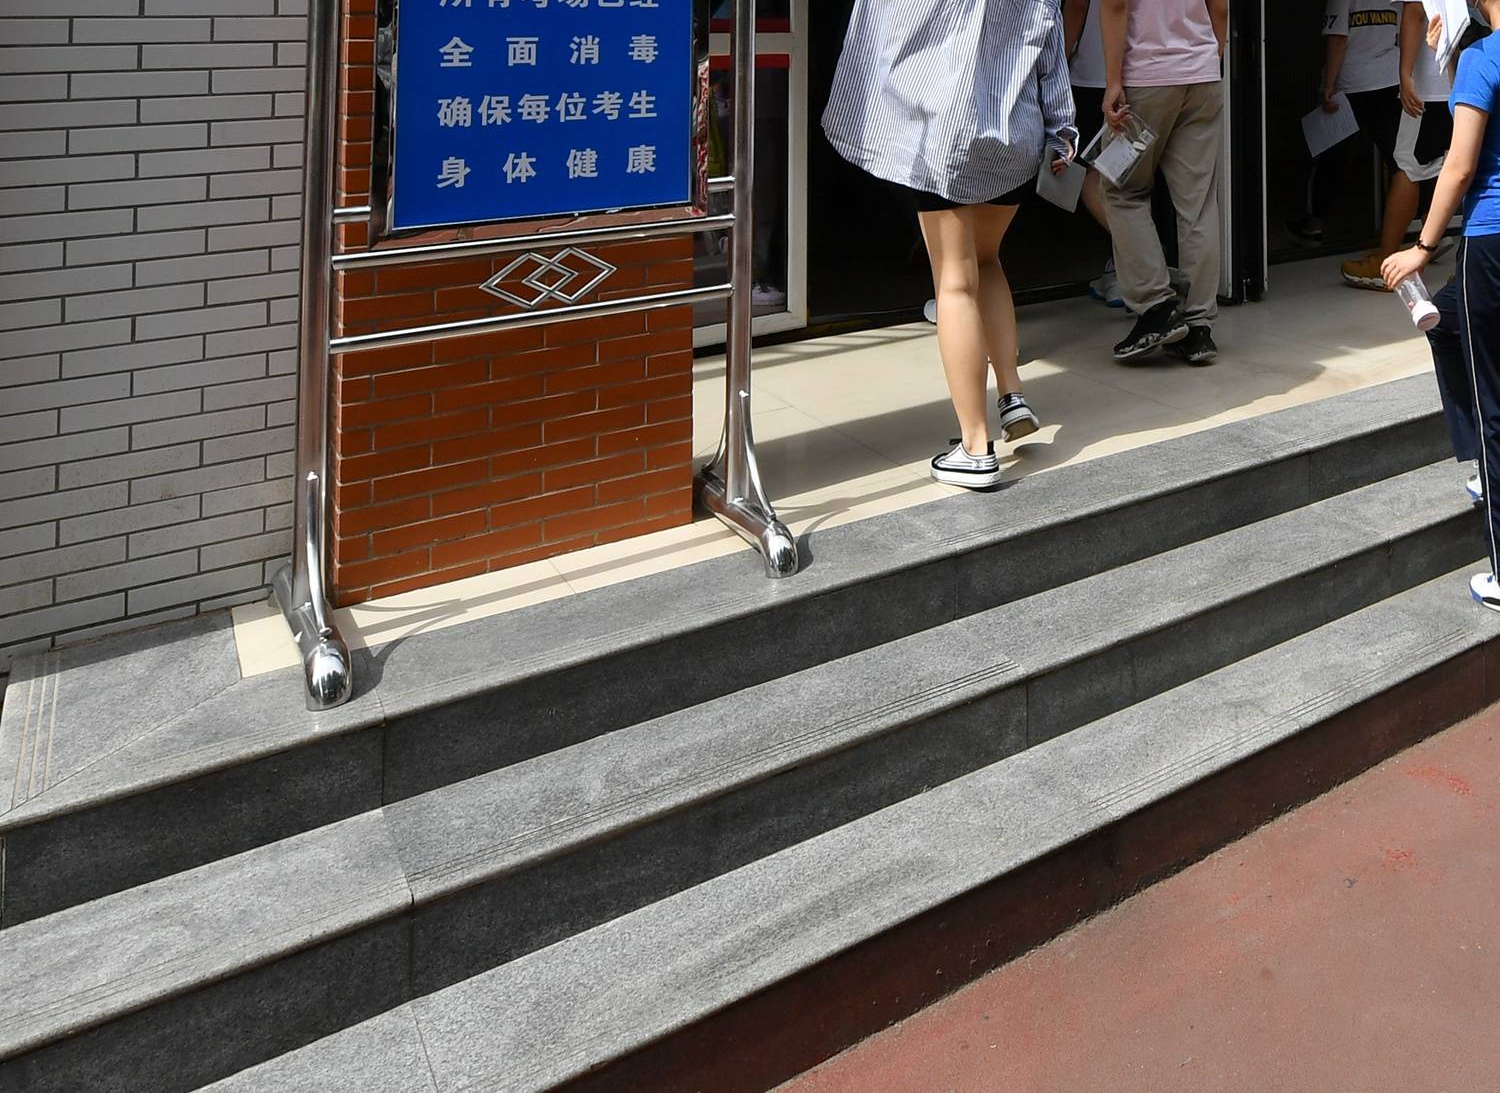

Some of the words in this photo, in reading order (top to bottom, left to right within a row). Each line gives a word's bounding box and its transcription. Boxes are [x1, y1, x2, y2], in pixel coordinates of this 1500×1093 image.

[437, 91, 658, 128] 确保每位考生
